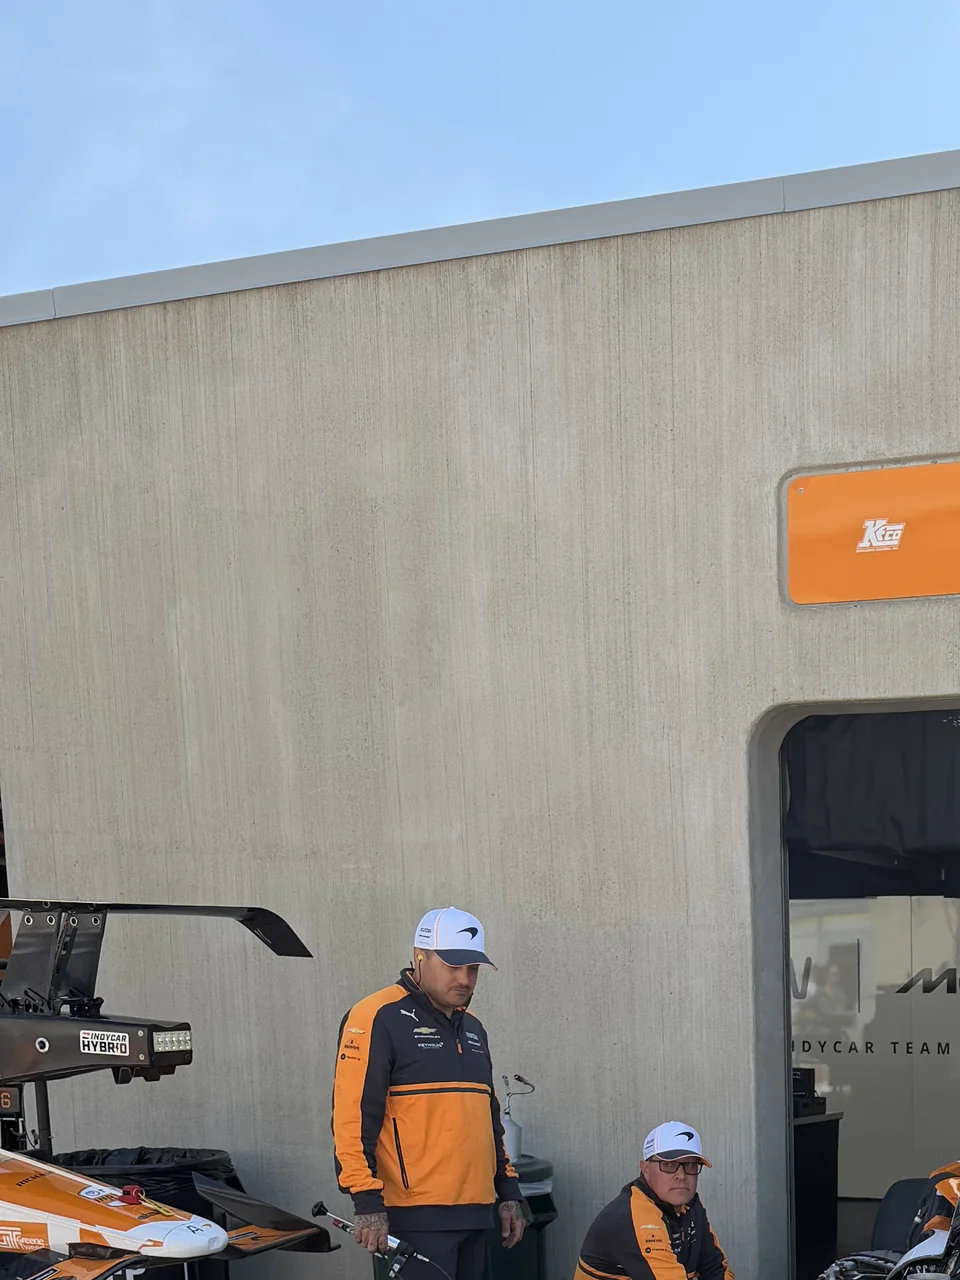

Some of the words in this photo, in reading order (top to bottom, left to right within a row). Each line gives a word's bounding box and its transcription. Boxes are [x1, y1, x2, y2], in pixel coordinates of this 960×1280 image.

[90, 1032, 128, 1043] INDYCAR
[81, 1039, 128, 1054] HYBRID
[890, 1041, 951, 1055] TEAM
